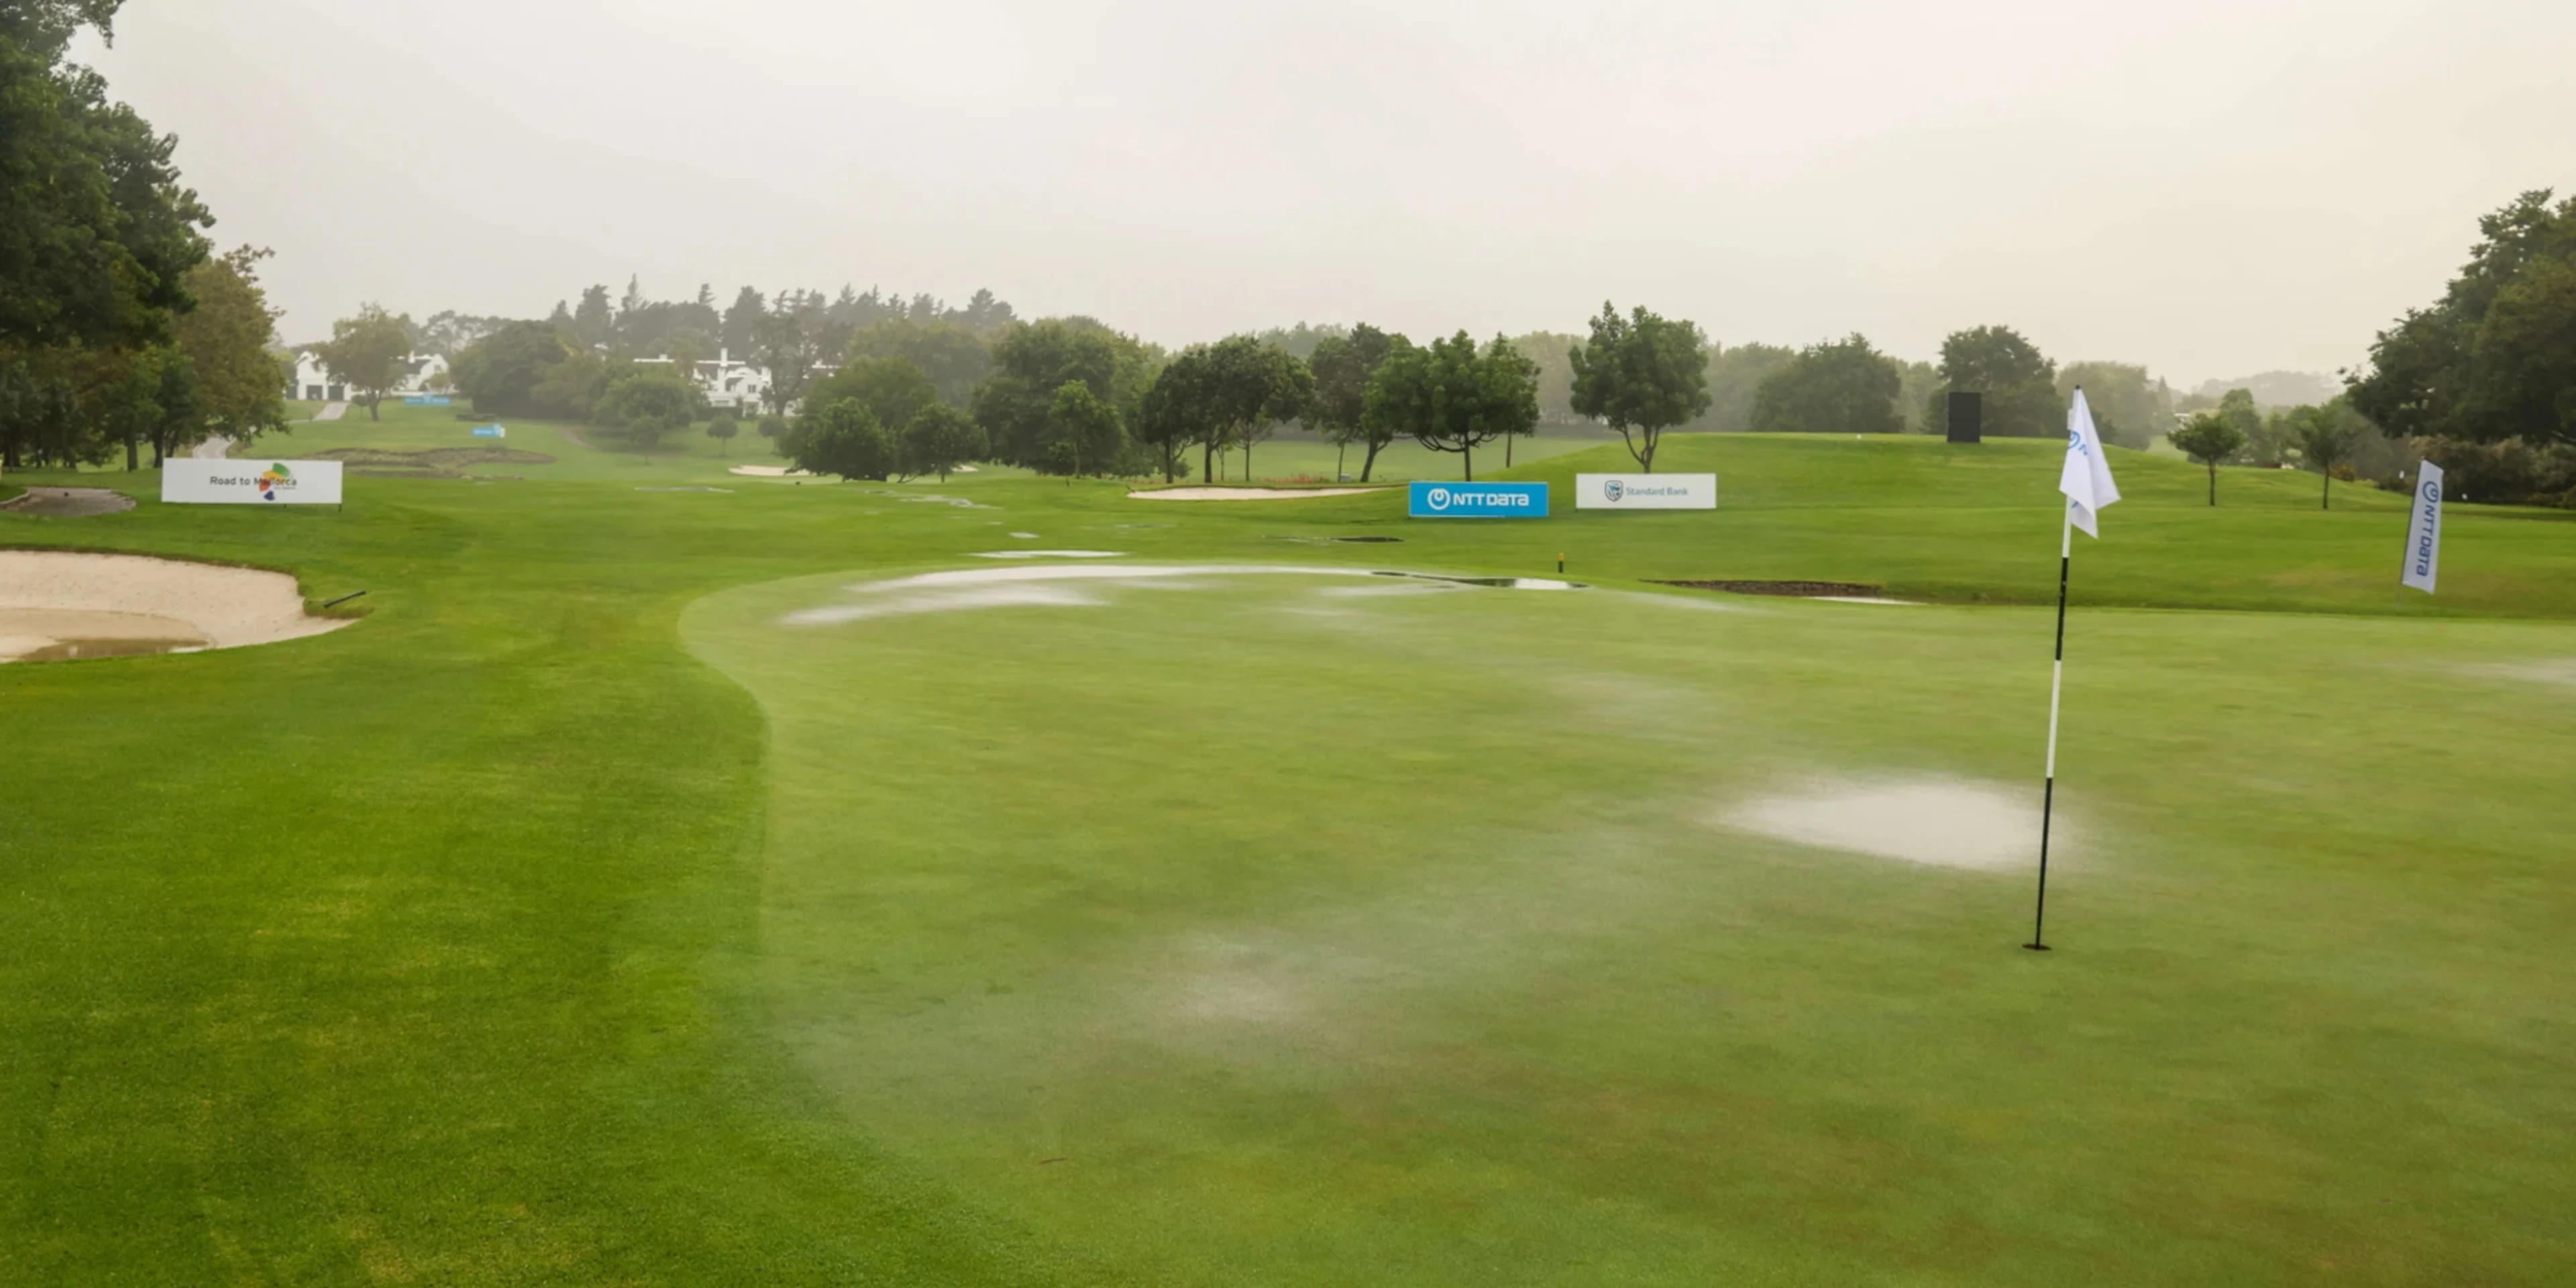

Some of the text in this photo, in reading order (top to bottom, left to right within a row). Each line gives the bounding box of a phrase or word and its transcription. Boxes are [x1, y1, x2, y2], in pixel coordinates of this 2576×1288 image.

[210, 476, 236, 485] Road
[239, 476, 250, 486] to
[1626, 486, 1688, 496] Standard Bank
[1453, 493, 1485, 506] NTT
[2422, 504, 2434, 536] NTT
